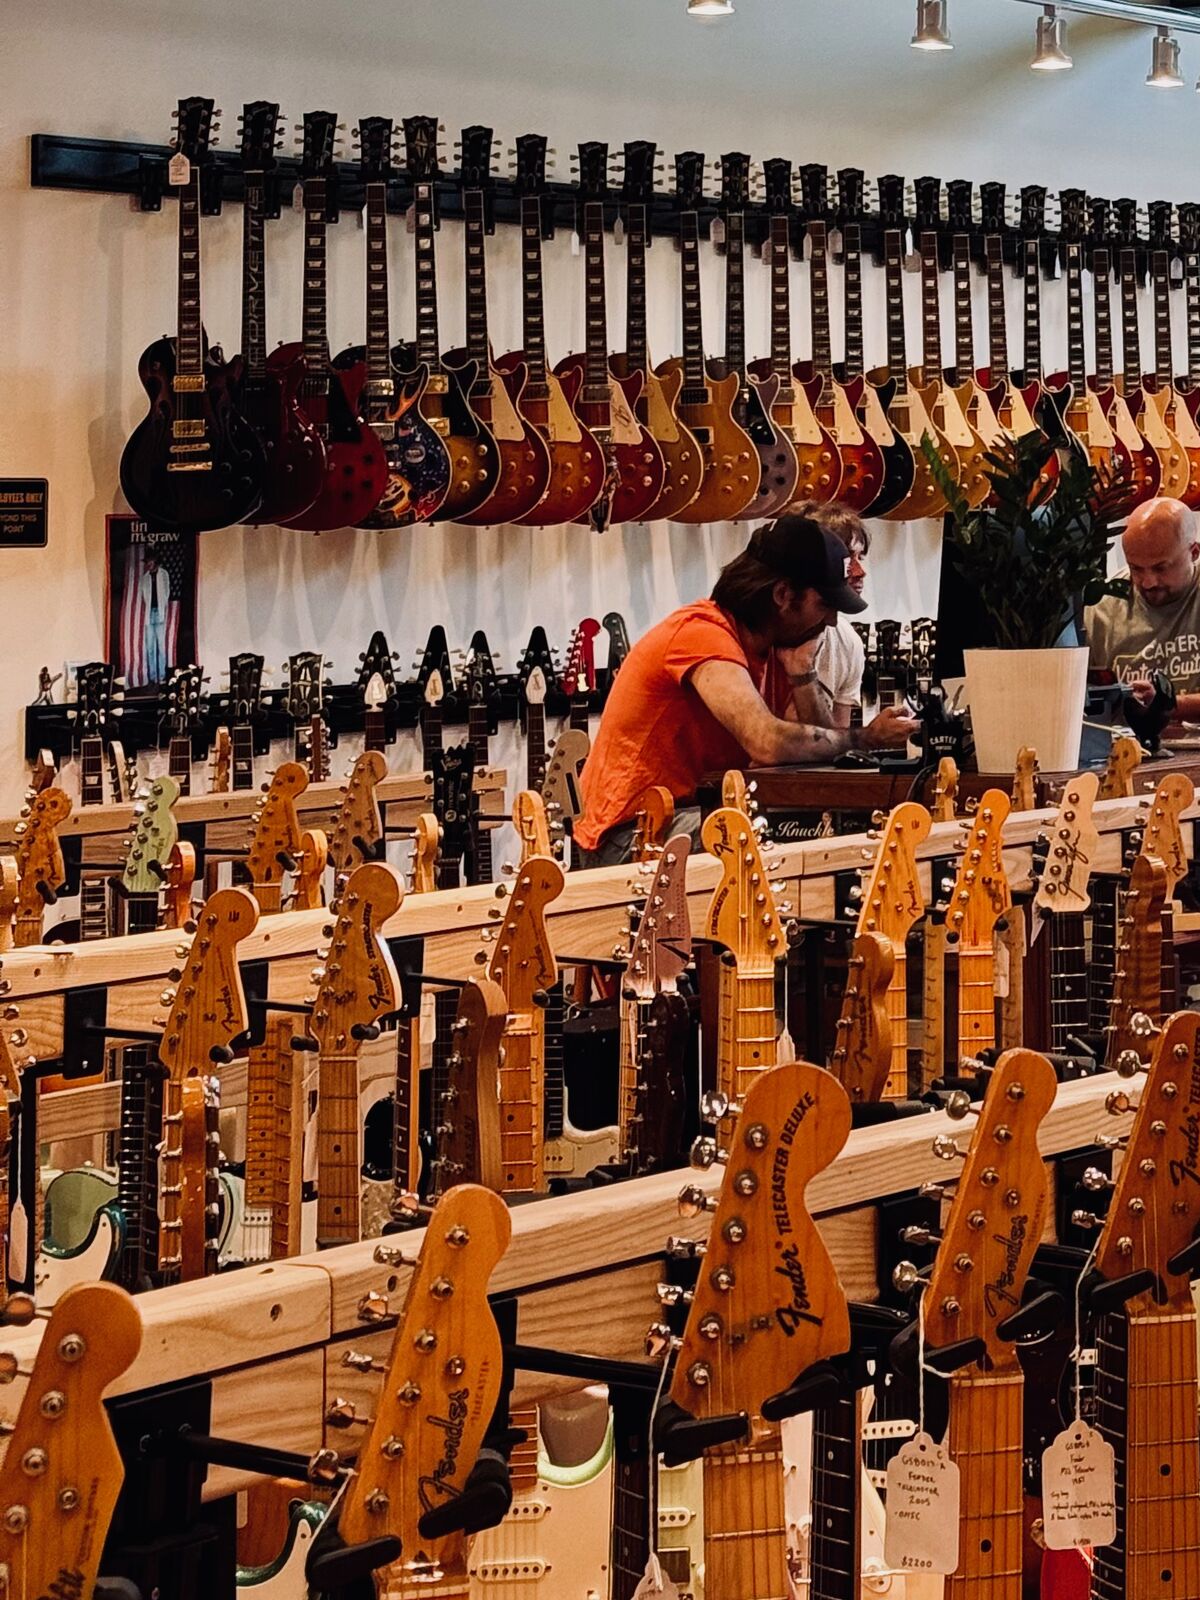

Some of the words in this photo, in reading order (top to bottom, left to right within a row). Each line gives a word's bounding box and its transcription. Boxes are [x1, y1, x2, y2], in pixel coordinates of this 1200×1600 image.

[248, 187, 261, 367] CORVETTE
[713, 815, 734, 857] Fender
[776, 821, 835, 838] Knuckle
[903, 880, 923, 917] Fender
[216, 985, 240, 1034] Fender
[368, 963, 392, 1010] Fender
[780, 1091, 815, 1147] DELUXE
[771, 1147, 793, 1236] TELECASTER
[775, 1242, 824, 1337] Fender
[984, 1213, 1028, 1318] Fender
[418, 1387, 470, 1512] Fender
[901, 1555, 933, 1568] $2200
